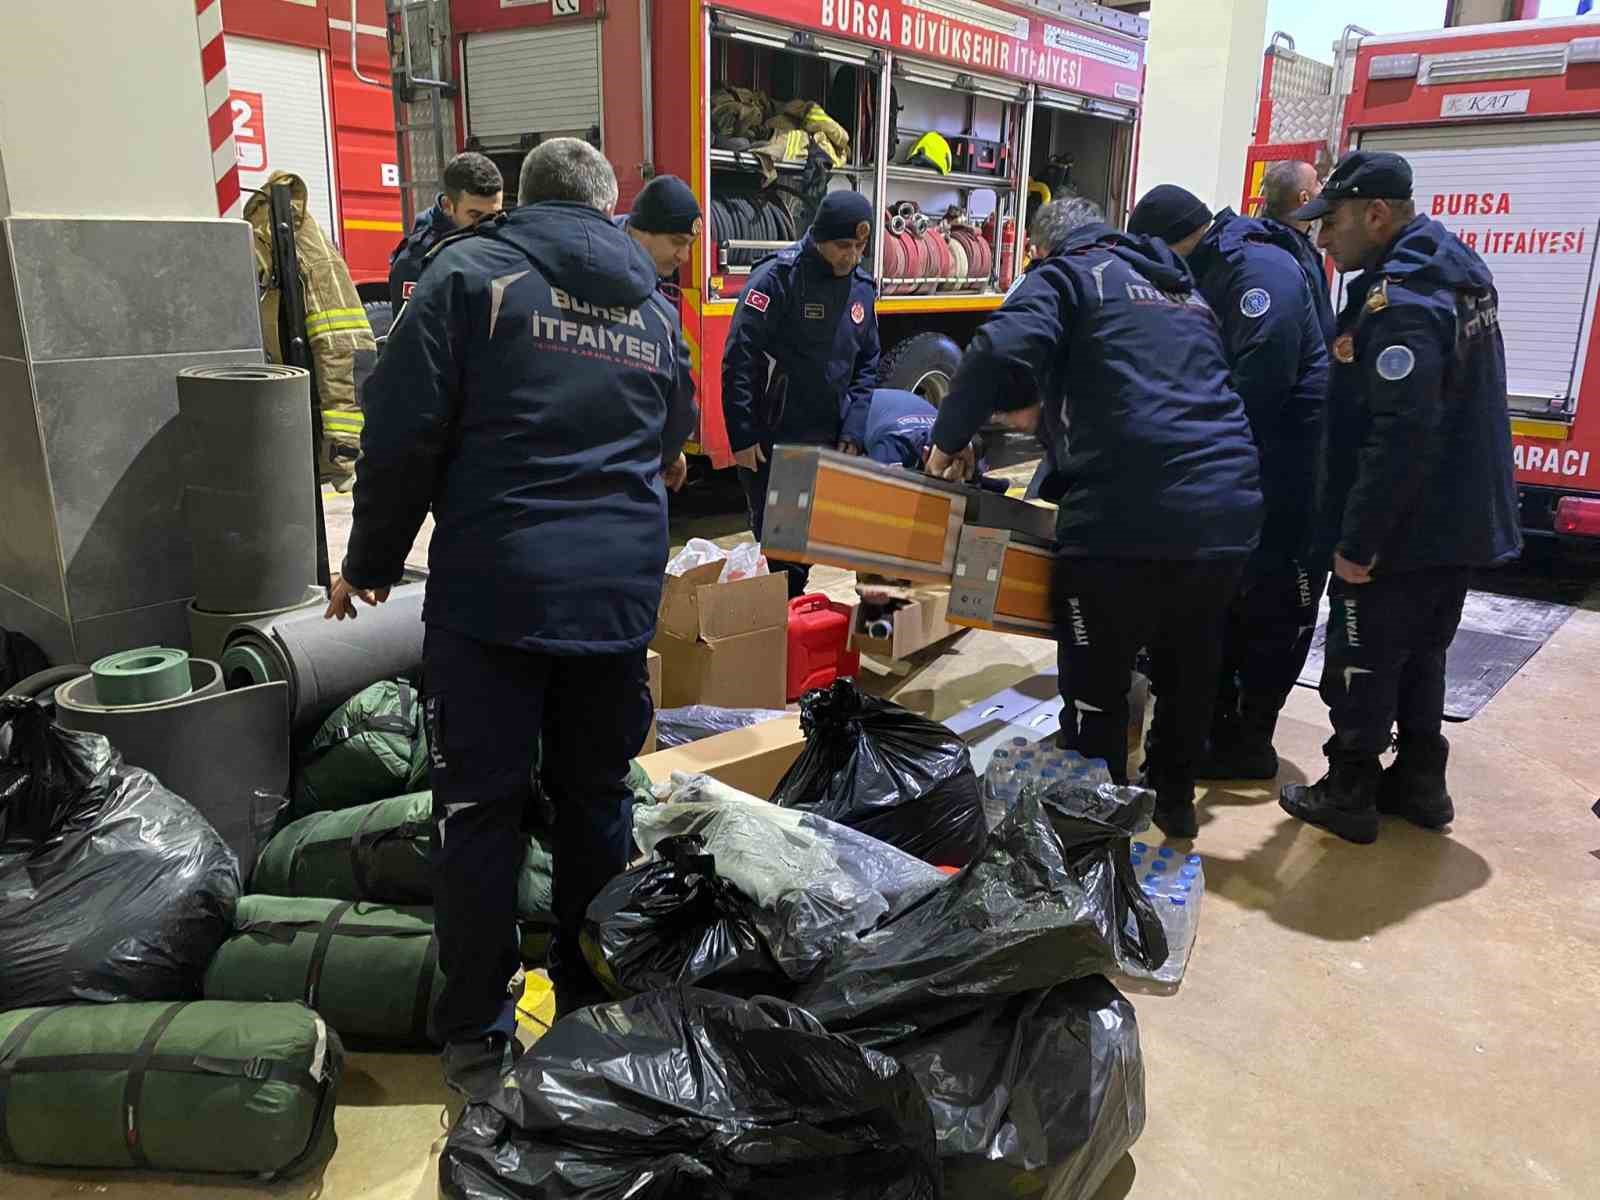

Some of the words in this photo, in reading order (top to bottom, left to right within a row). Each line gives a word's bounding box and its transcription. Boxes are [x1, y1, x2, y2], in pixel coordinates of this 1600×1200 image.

[821, 0, 892, 41] BURSA
[901, 12, 1009, 71] BÜYÜKŞEHİR
[1431, 192, 1511, 216] BURSA
[1483, 227, 1586, 255] İTFAİYESİ
[532, 309, 662, 368] İTFAİYESİ
[1513, 444, 1590, 477] ARACI
